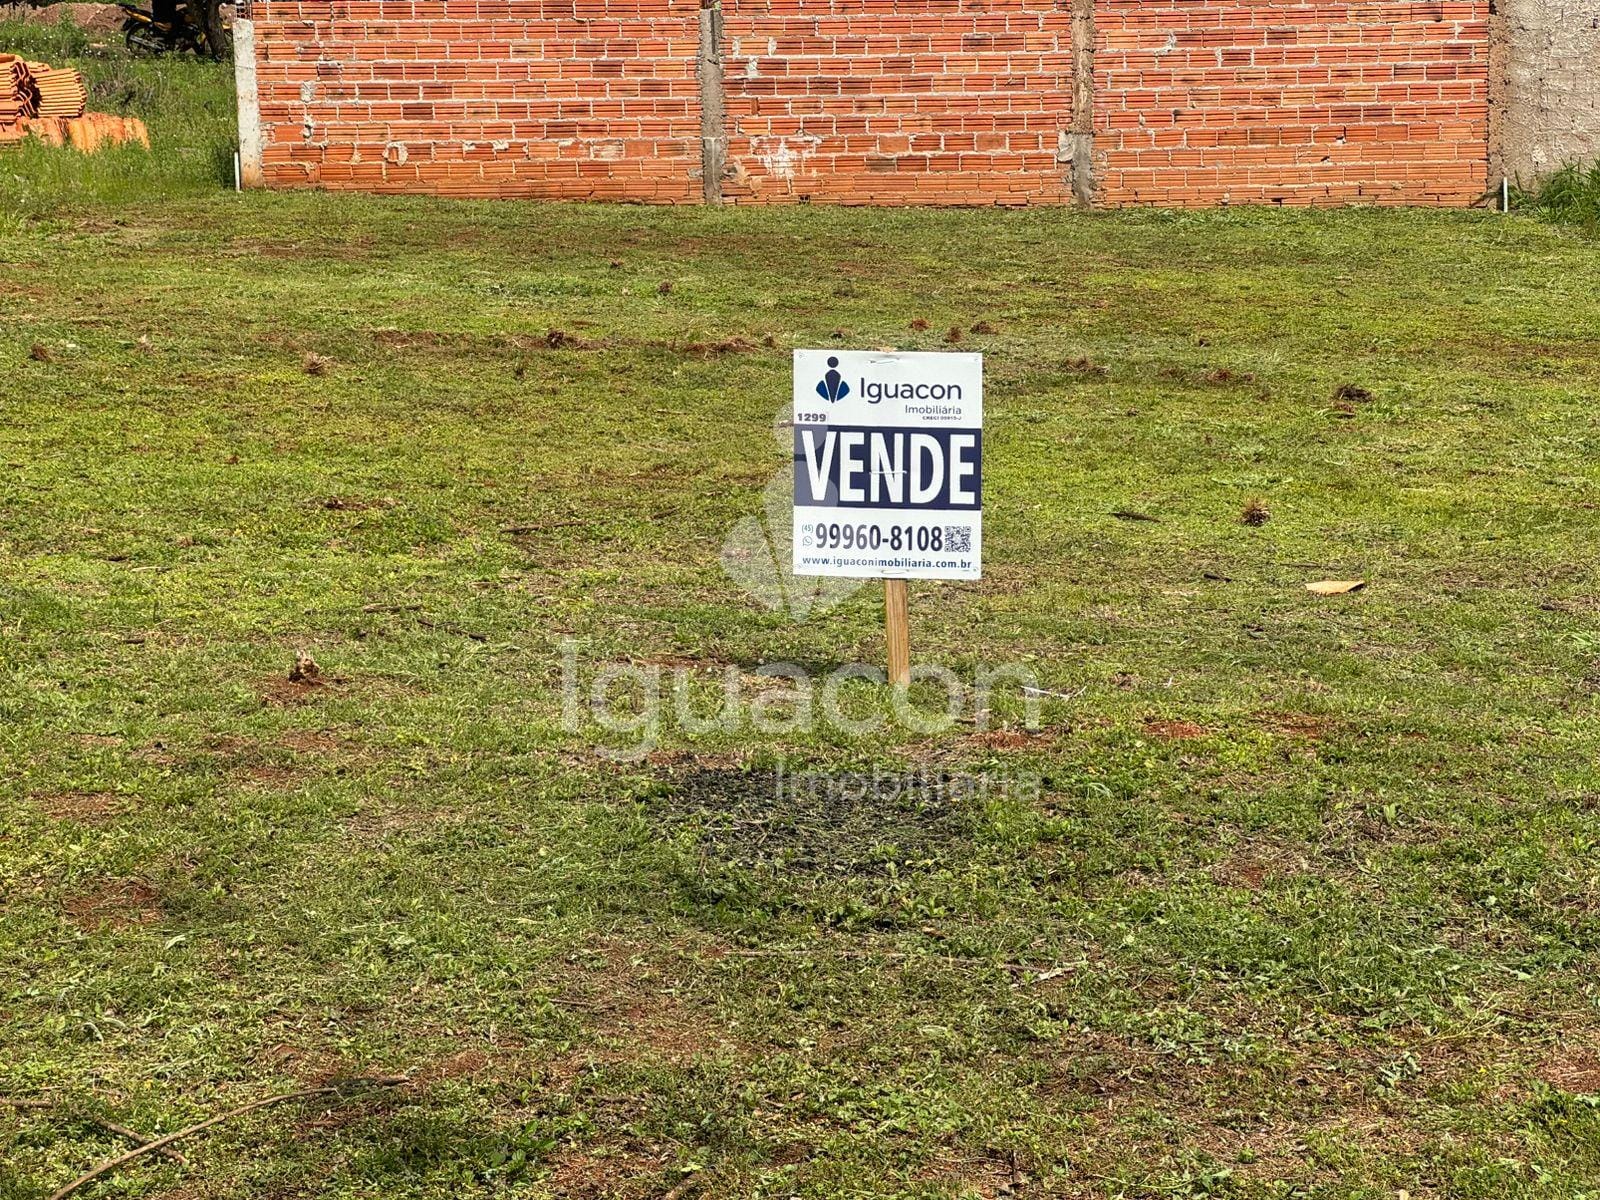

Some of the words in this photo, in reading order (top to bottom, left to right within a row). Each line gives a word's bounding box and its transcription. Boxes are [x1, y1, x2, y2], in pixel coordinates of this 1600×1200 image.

[860, 377, 962, 404] Iguacon
[905, 404, 962, 415] Imobiliária
[797, 413, 827, 422] 1299
[801, 430, 976, 505] VENDE
[801, 524, 814, 534] (45)
[816, 523, 943, 552] 99960-8108
[802, 556, 972, 569] www.iguaconimobiliaria.com.br
